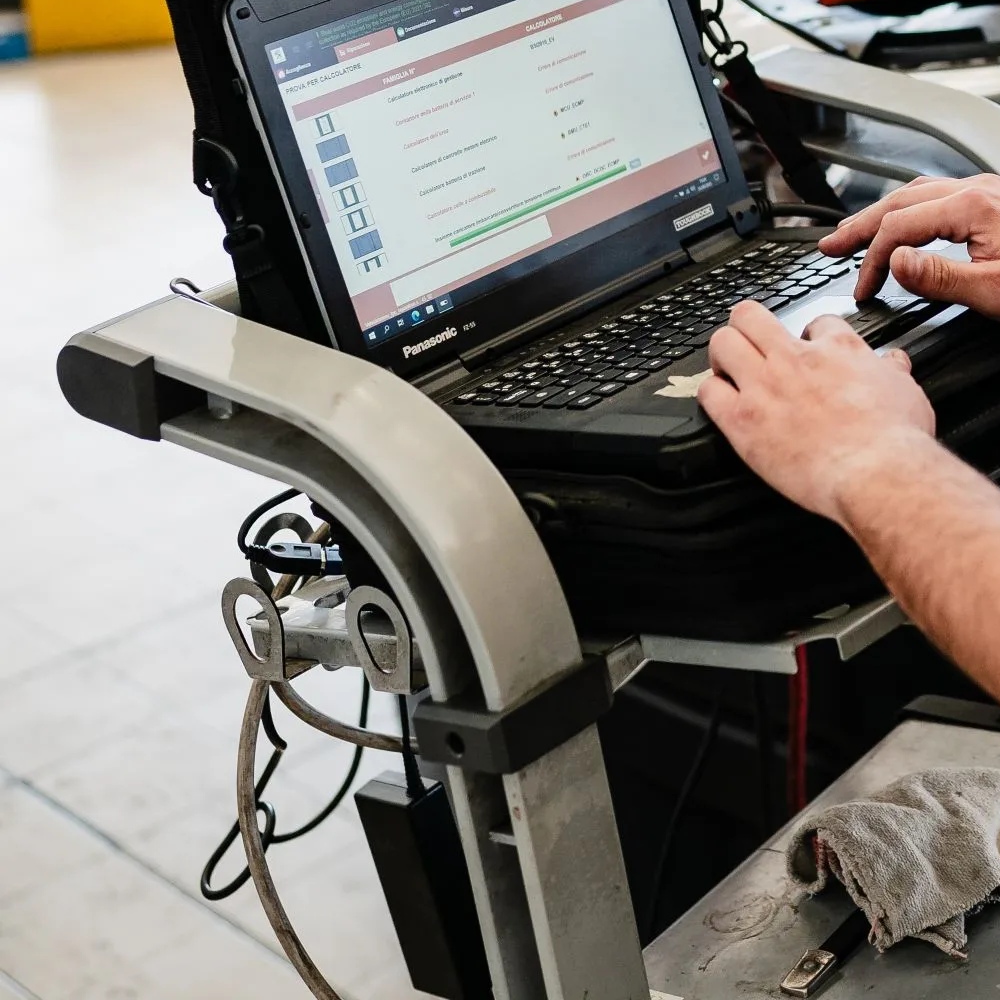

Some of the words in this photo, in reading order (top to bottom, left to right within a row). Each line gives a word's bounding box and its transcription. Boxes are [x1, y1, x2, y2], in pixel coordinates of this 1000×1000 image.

[525, 14, 563, 32] CALCOLATORE
[286, 83, 306, 94] PROVA
[306, 77, 319, 87] PER
[320, 63, 362, 82] CALCOLATORE
[383, 70, 409, 84] FAMIGLIA
[387, 89, 413, 103] Calcolatore
[414, 80, 438, 93] elettronico
[444, 72, 463, 83] gestione
[403, 136, 429, 150] Calcolatore
[411, 159, 437, 173] Calcolatore
[443, 149, 462, 160] controllo
[480, 135, 498, 145] elettrico
[419, 182, 445, 196] Calcolatore
[445, 175, 463, 186] batteria
[468, 165, 486, 176] trazione
[676, 206, 712, 227] TOUGHBOOK
[435, 231, 453, 243] Insieme
[453, 222, 475, 235] caricatore
[402, 327, 457, 358] Panasonic
